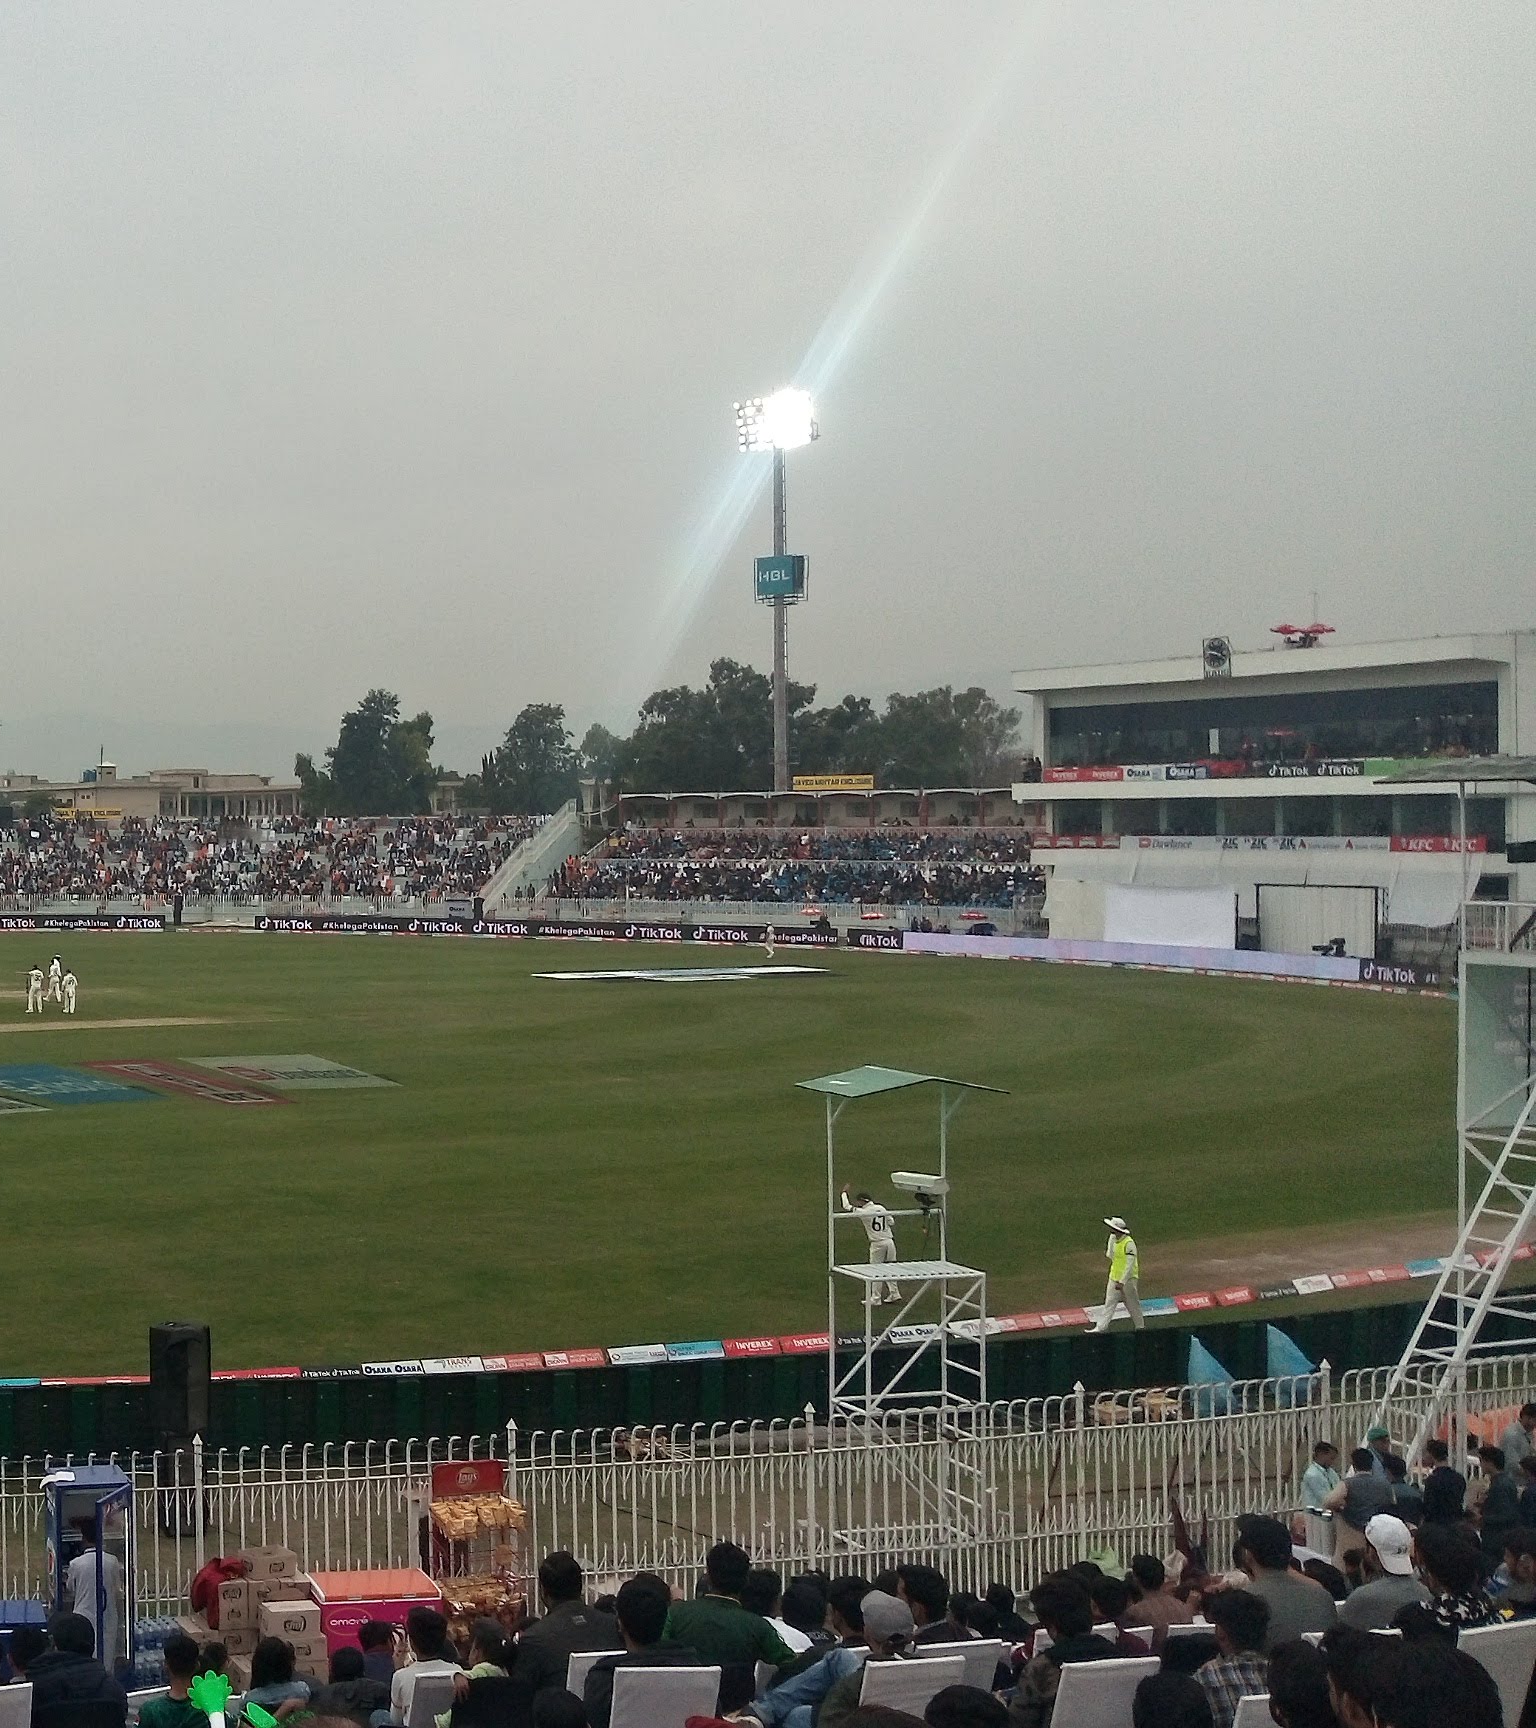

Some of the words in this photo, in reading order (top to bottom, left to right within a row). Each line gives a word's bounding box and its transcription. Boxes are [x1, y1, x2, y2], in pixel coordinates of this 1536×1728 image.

[759, 570, 790, 583] HBL
[1279, 766, 1309, 777] TikTok
[1328, 764, 1360, 776] TikTok
[1408, 840, 1434, 850] KFC
[1, 918, 36, 928] TikTok
[44, 919, 109, 929] #KhelegaPakistan
[127, 918, 161, 928] TikTok
[273, 919, 312, 930] TikTok
[323, 921, 399, 931] #KhelegaPakistan
[422, 921, 463, 932] TikTok
[487, 923, 528, 934] TikTok
[538, 926, 615, 937] #KhelegaPakistan
[639, 927, 682, 939] TikTok
[707, 929, 749, 942] TikTok
[1378, 967, 1415, 984] TikTok
[872, 1215, 885, 1231] 67
[890, 1329, 913, 1339] OSAKA
[736, 1340, 773, 1350] INVEREX
[793, 1337, 830, 1347] INVEREX
[364, 1365, 392, 1374] OSAKA
[394, 1364, 422, 1373] OSAKA
